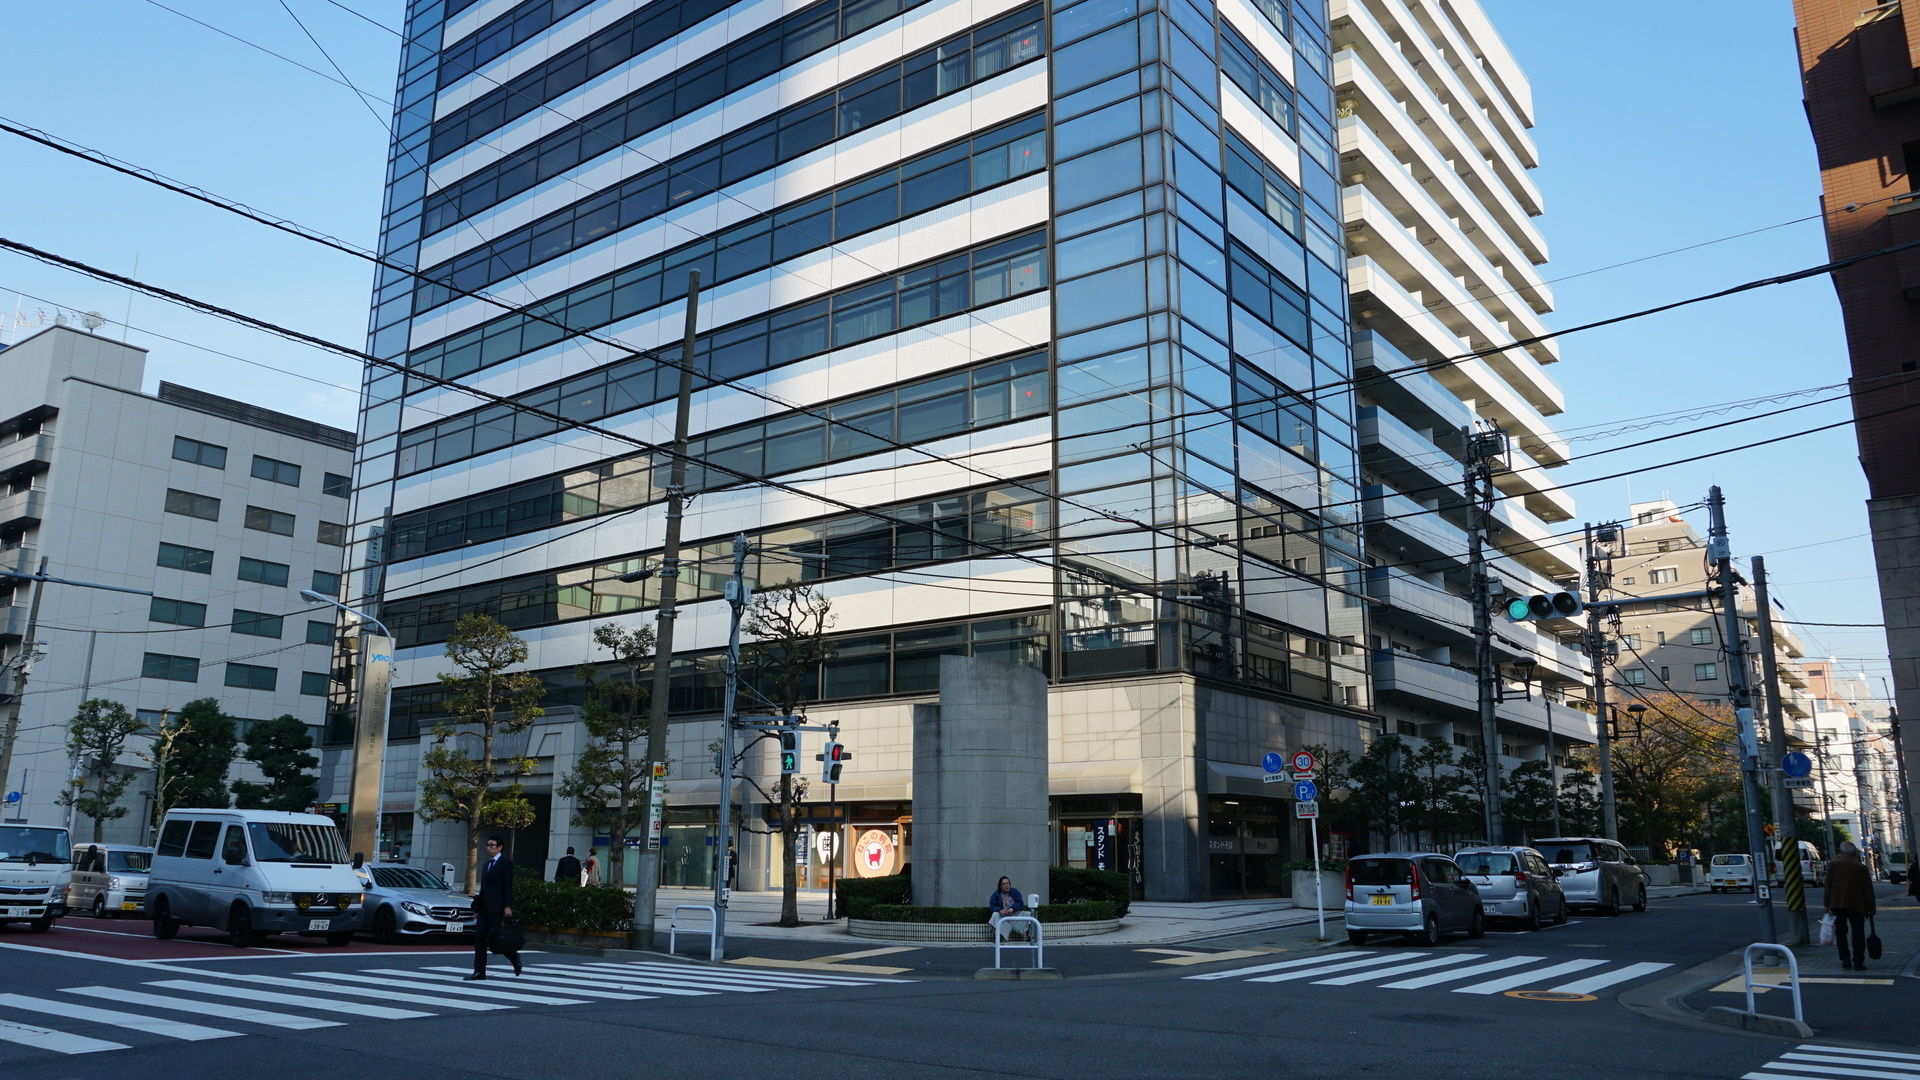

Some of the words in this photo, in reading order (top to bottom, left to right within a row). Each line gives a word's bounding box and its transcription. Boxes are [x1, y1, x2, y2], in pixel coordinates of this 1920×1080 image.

[371, 653, 390, 663] yec
[1298, 757, 1309, 767] 30
[1300, 786, 1308, 800] P
[822, 836, 833, 851] 歯
[857, 832, 893, 854] ねこの病院
[1097, 826, 1105, 859] スタンド
